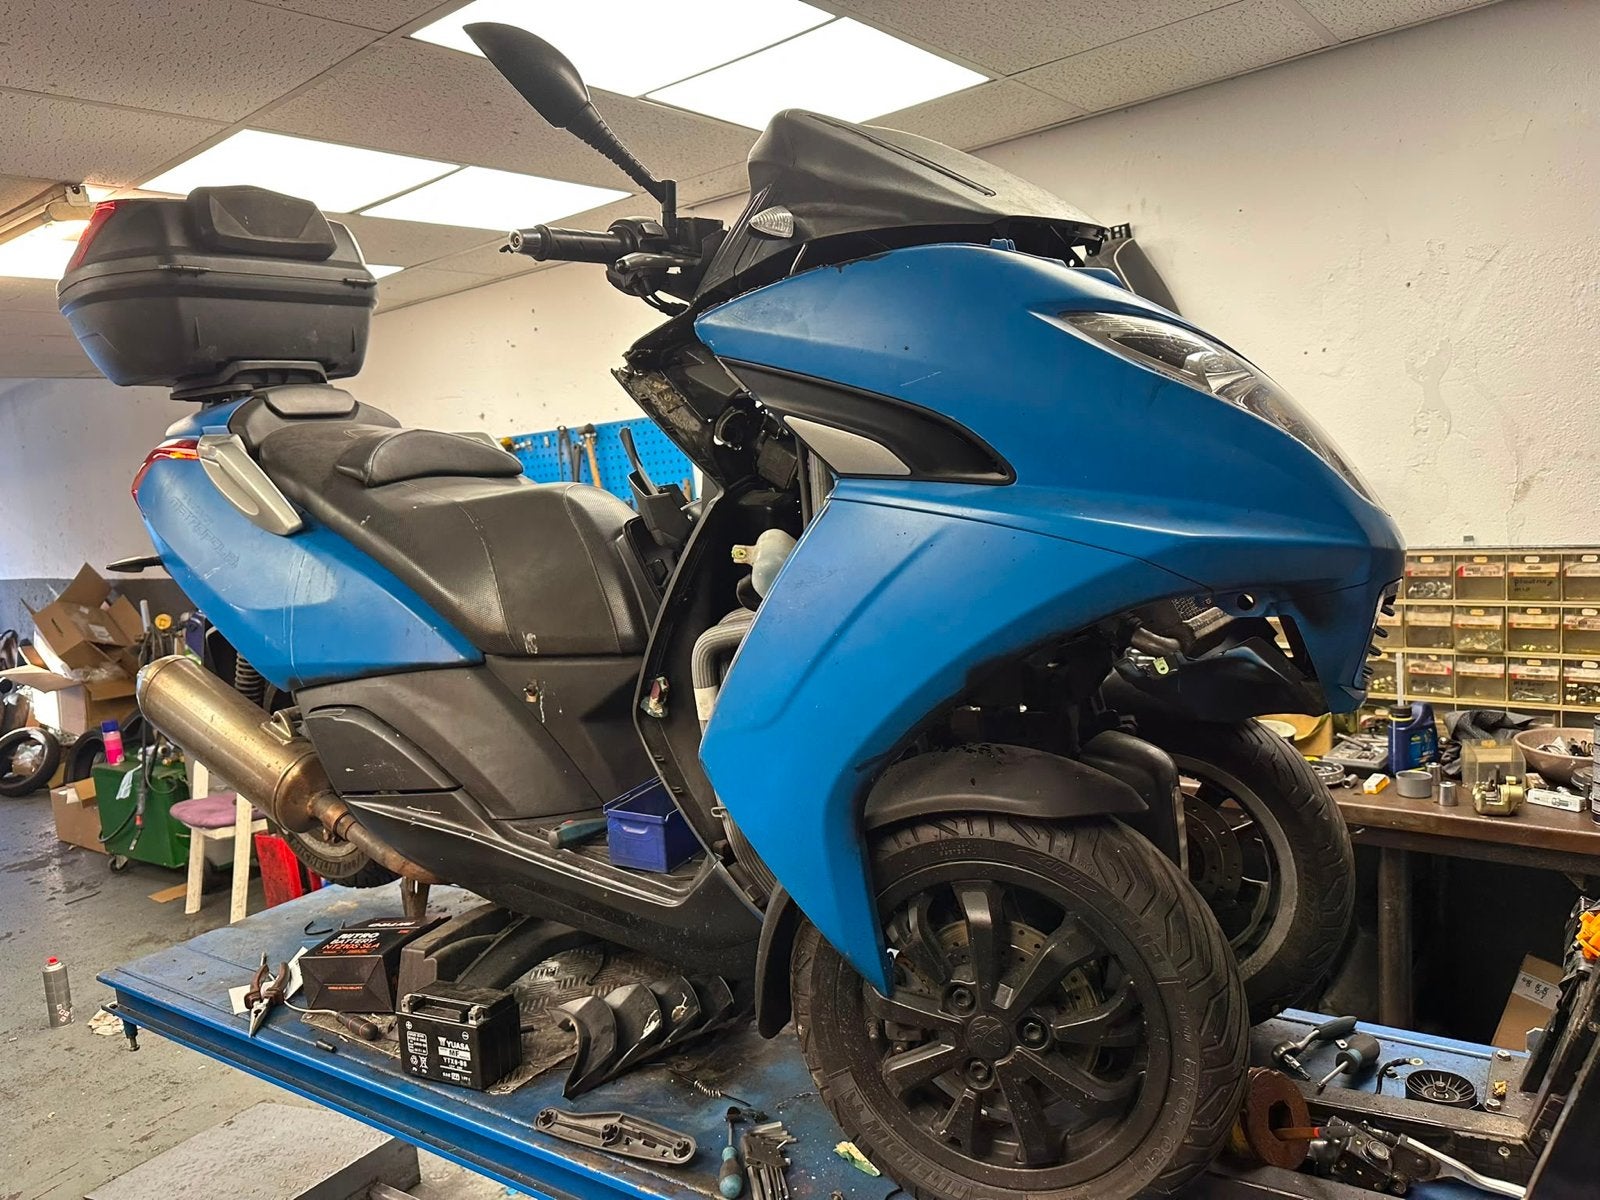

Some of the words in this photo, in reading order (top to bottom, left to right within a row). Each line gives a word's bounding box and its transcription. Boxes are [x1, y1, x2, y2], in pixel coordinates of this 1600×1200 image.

[337, 932, 380, 940] NITRO
[446, 1040, 470, 1051] YUASA
[861, 1118, 970, 1198] MICHELIN
